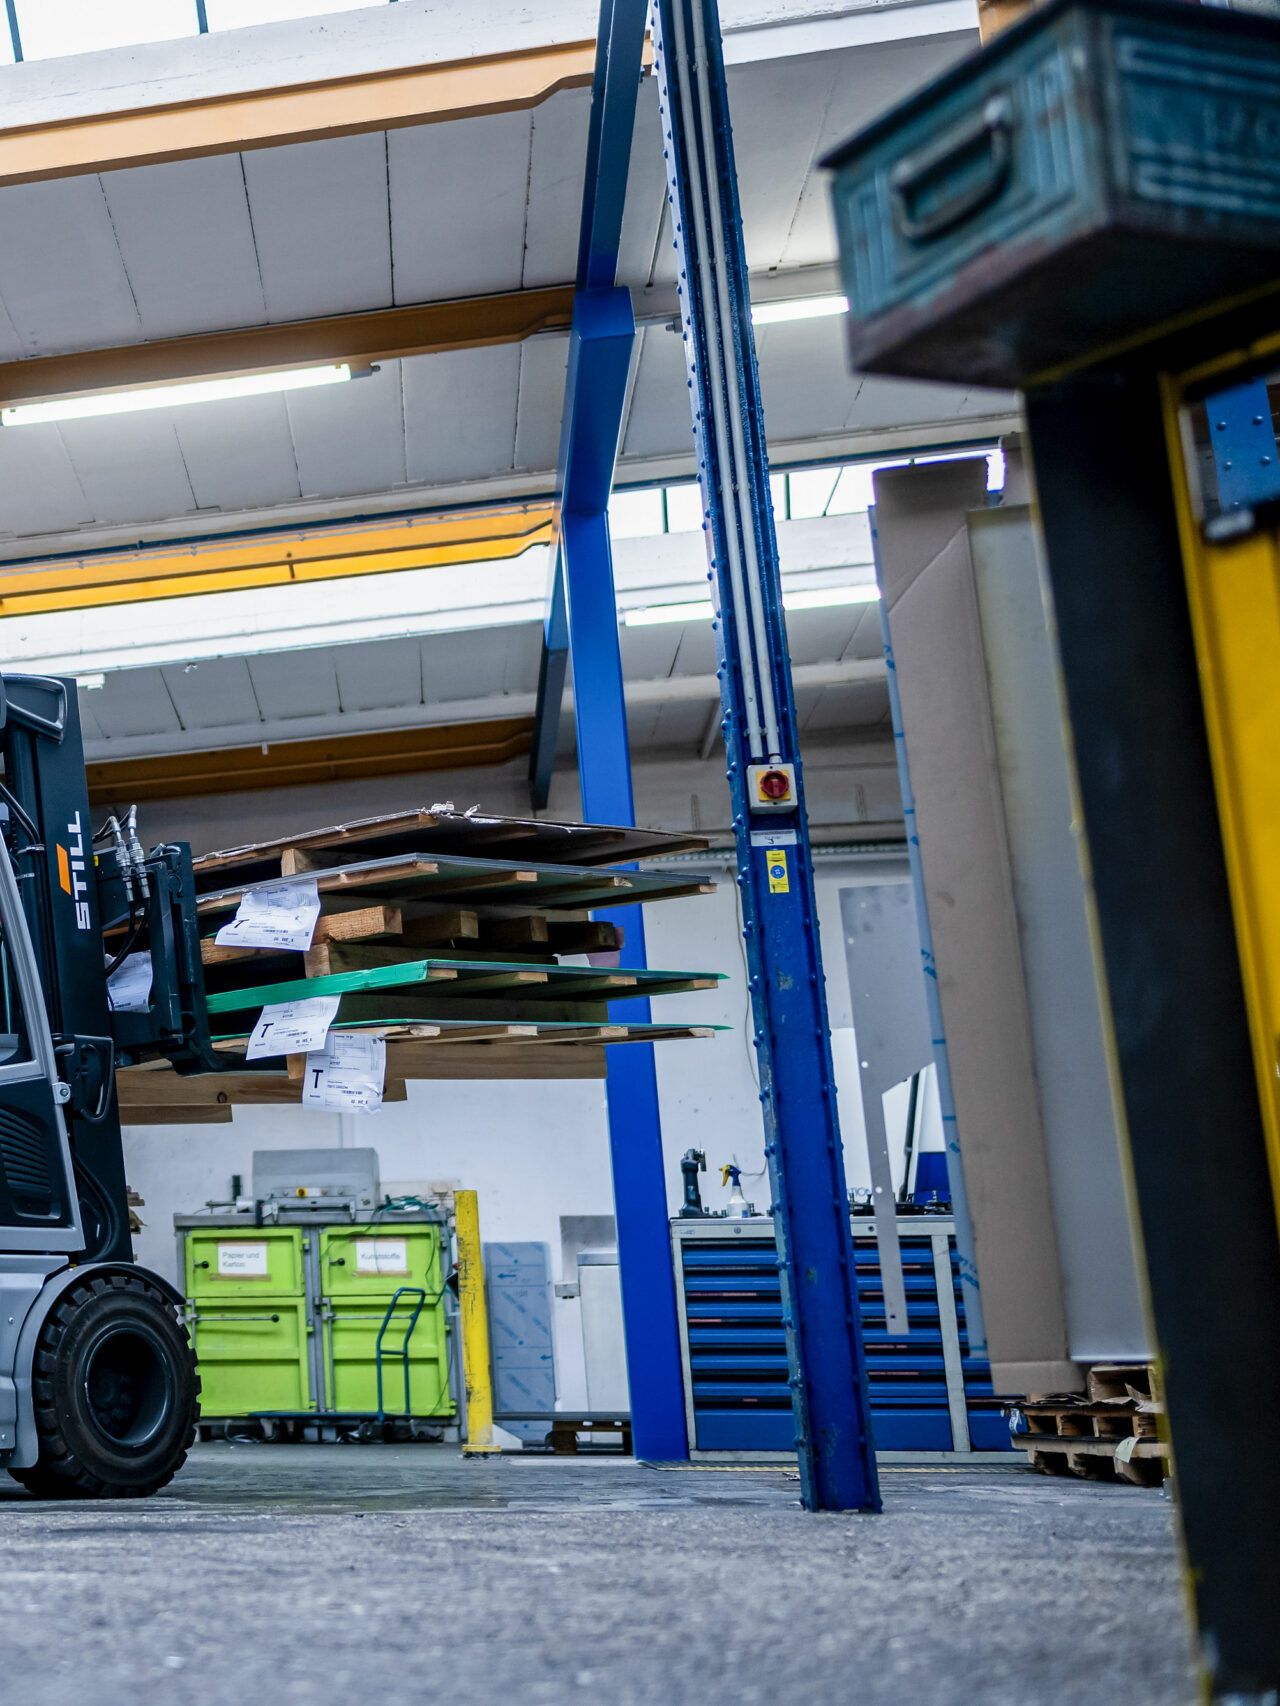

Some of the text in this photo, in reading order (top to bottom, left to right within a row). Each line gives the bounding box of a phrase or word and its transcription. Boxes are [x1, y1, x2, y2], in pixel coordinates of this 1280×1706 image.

[67, 810, 91, 930] STILL
[261, 1022, 274, 1039] T
[312, 1068, 324, 1089] T
[222, 1251, 260, 1262] Papier und
[222, 1261, 246, 1269] Karton
